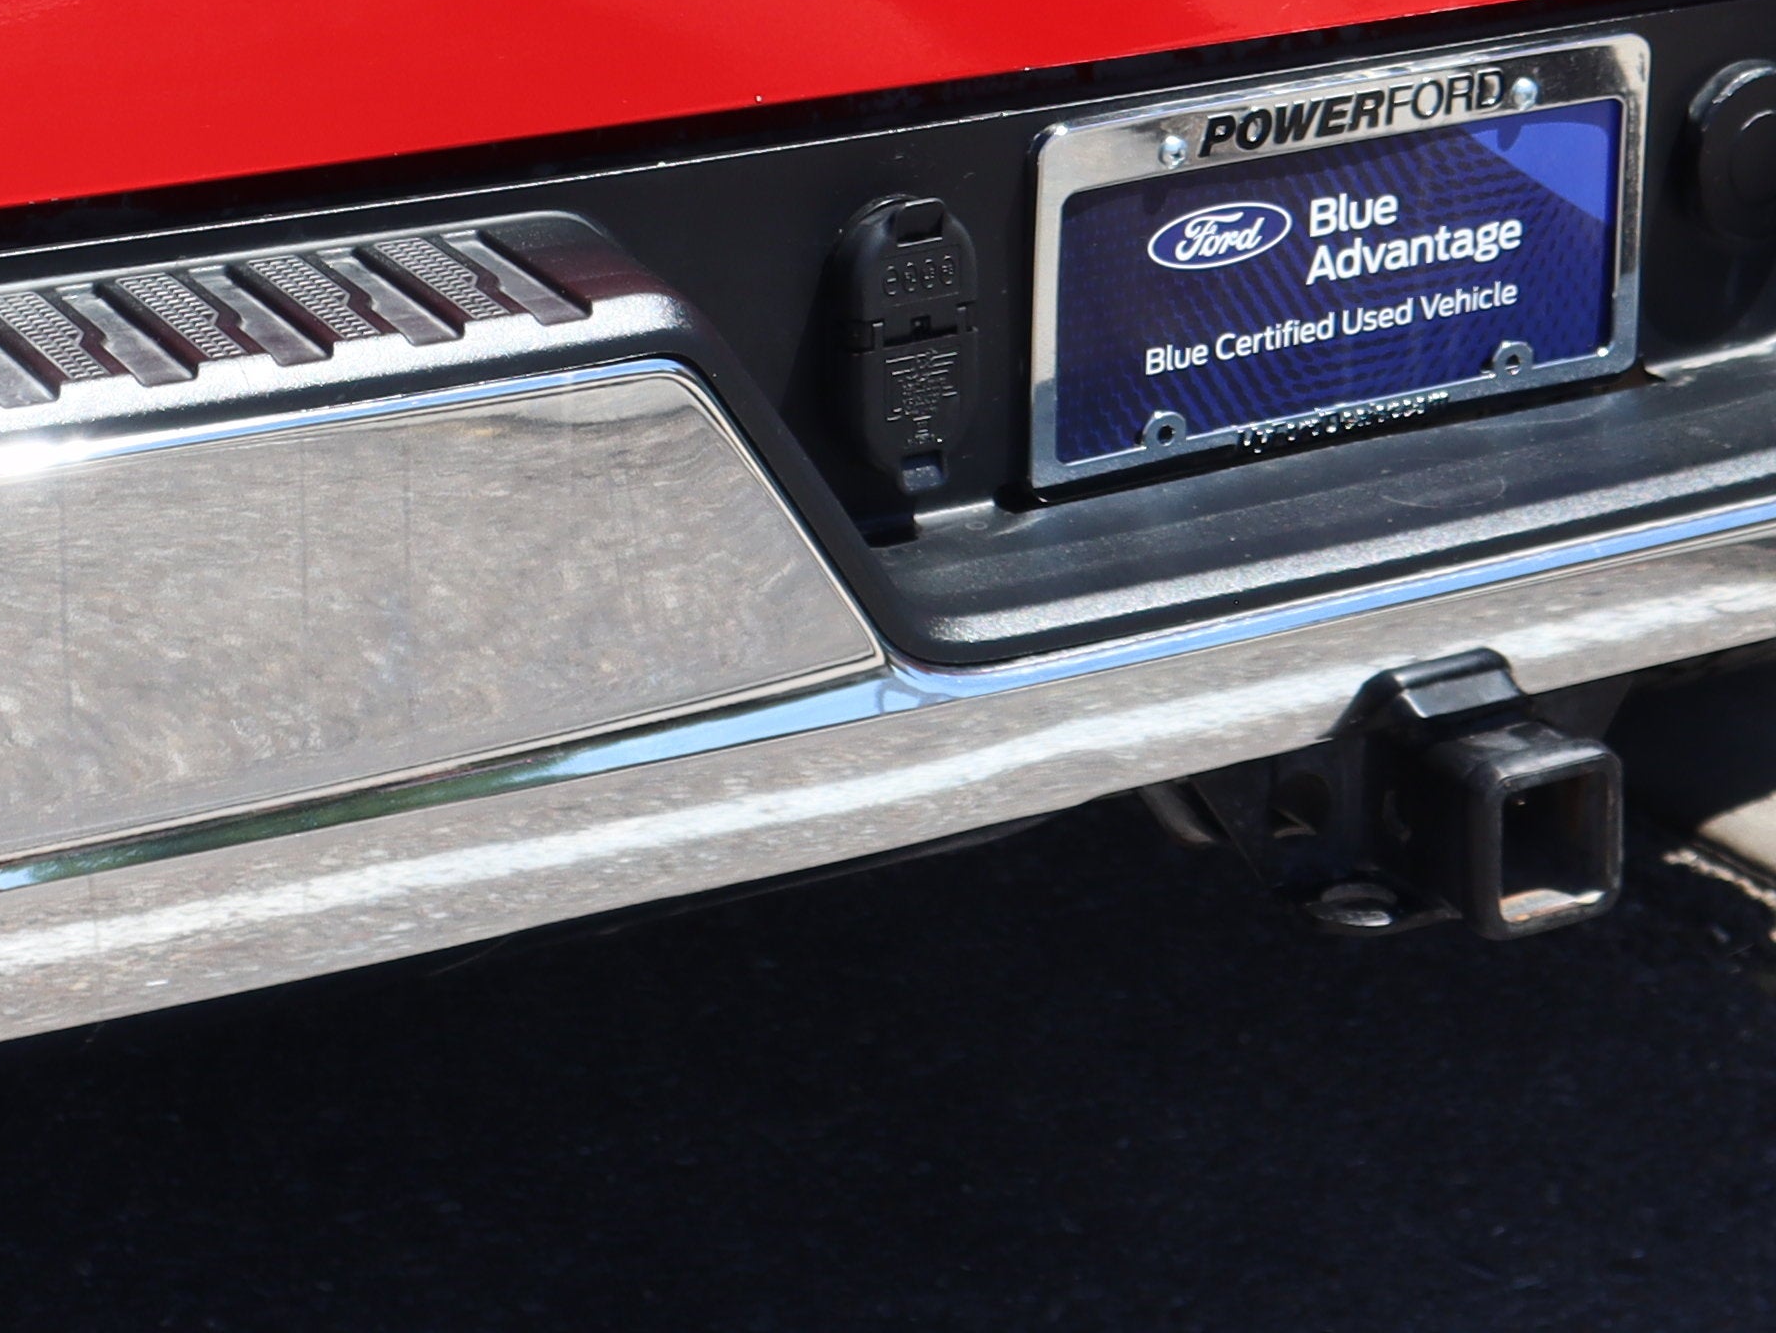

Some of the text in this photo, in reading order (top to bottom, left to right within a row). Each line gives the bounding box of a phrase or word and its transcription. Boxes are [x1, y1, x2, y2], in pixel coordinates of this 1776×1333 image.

[1174, 211, 1266, 262] Ford
[1309, 192, 1399, 238] Blue
[1305, 218, 1524, 286] Advantage
[1144, 280, 1518, 376] Blue Certified Used Vehicle
